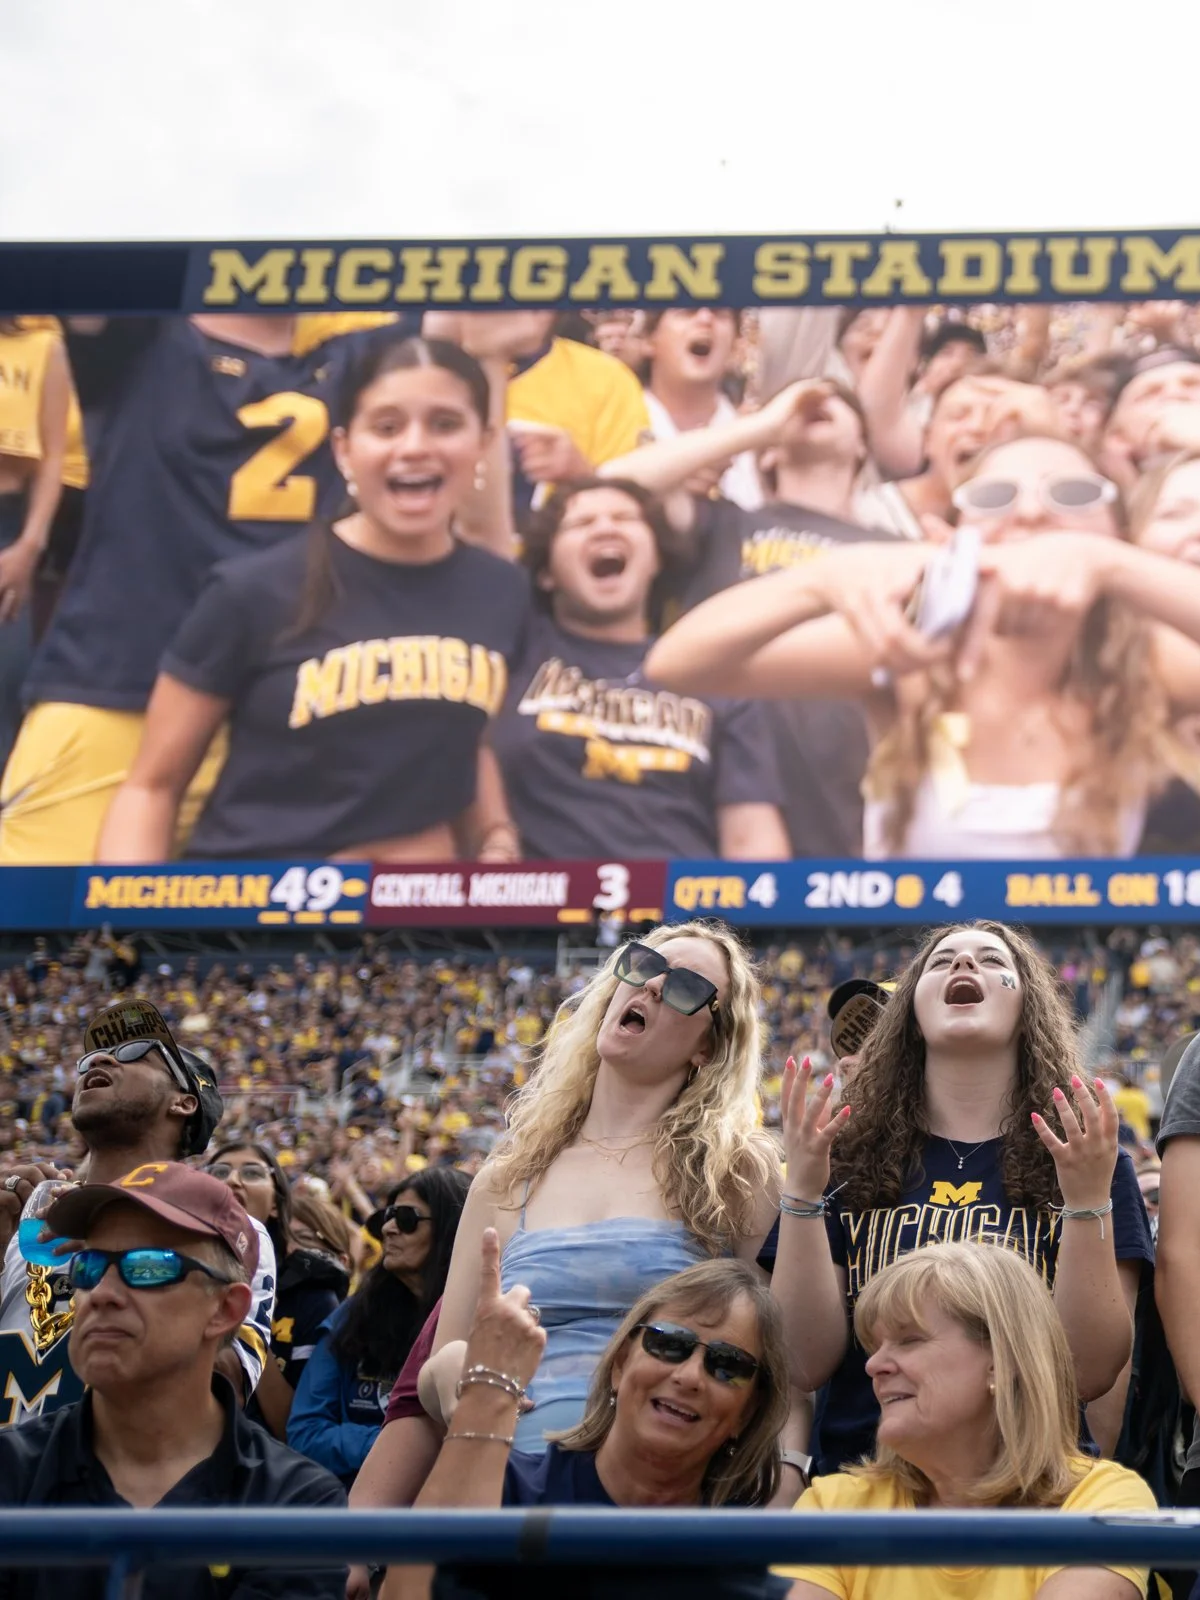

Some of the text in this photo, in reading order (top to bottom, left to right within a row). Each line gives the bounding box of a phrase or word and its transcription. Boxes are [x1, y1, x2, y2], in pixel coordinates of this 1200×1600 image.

[203, 245, 724, 304] MICHIGAN
[228, 391, 328, 521] 2
[86, 875, 272, 909] MICHIGAN
[271, 866, 343, 911] 49
[371, 873, 466, 907] CENTRAL
[593, 864, 630, 911] 3
[674, 872, 778, 911] QTR 4
[805, 871, 895, 908] 2ND
[932, 871, 964, 908] 4
[1005, 873, 1100, 907] BALL
[1107, 873, 1159, 906] ON
[120, 1163, 168, 1187] C
[929, 1181, 983, 1206] M
